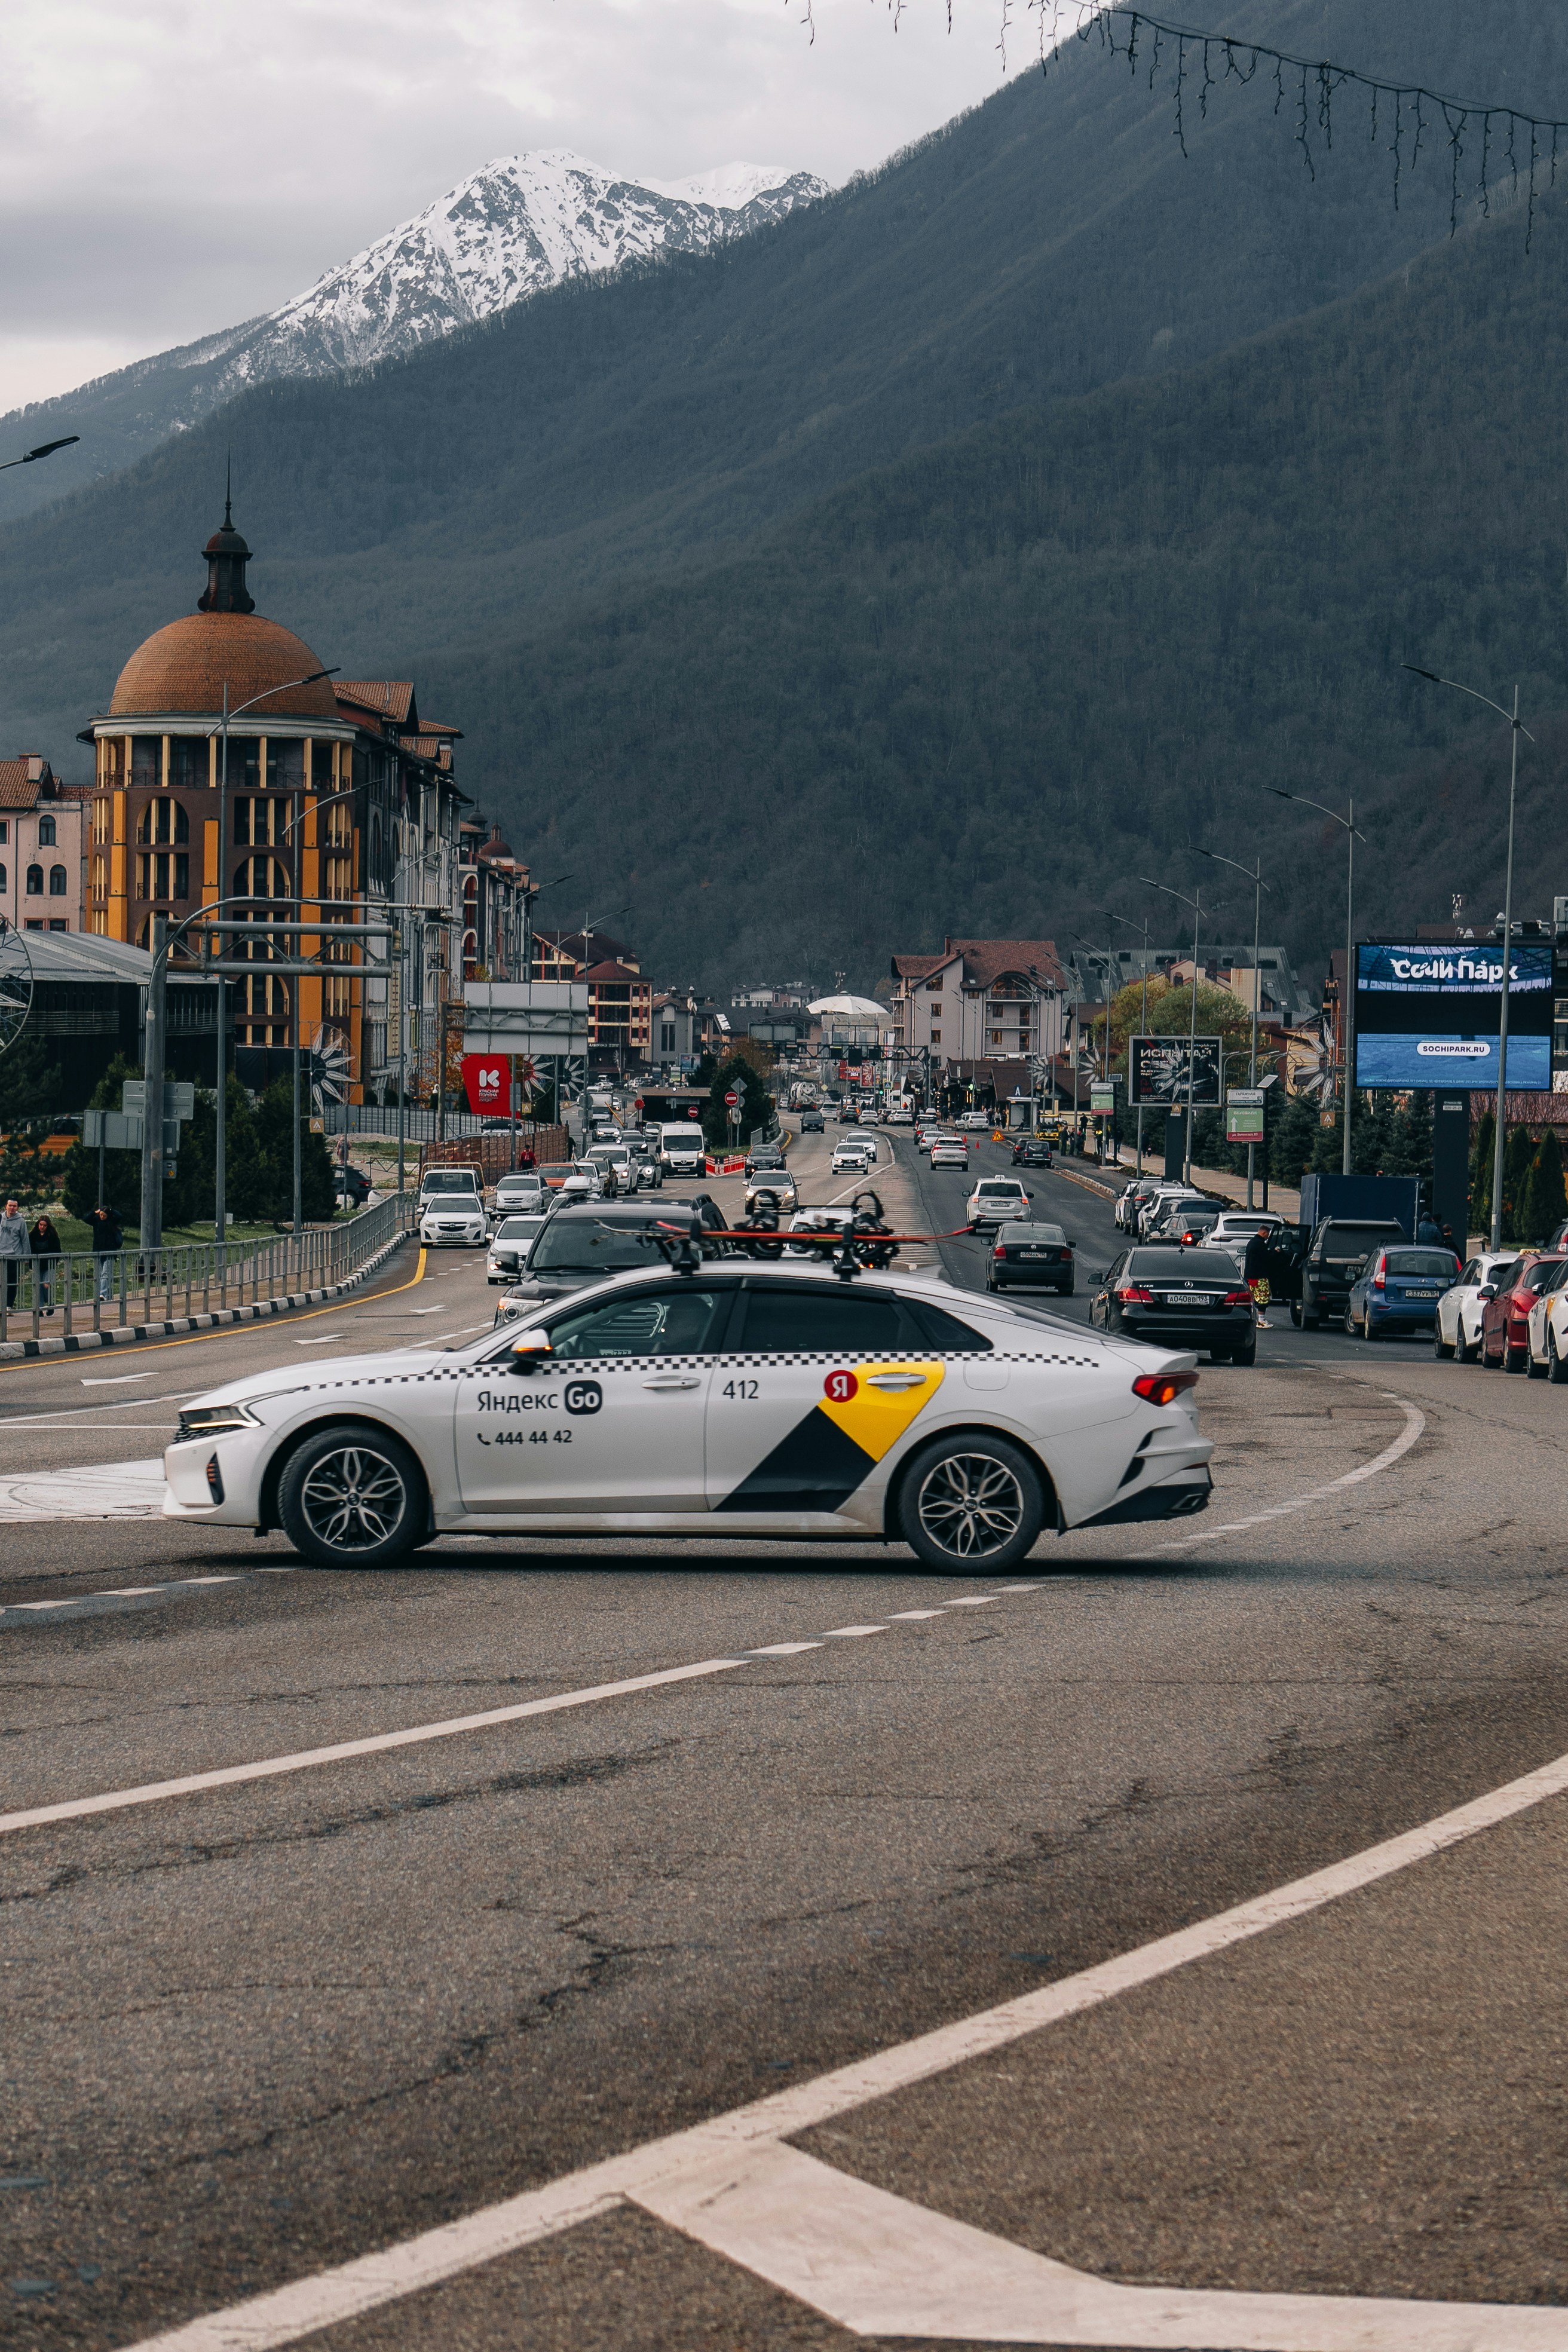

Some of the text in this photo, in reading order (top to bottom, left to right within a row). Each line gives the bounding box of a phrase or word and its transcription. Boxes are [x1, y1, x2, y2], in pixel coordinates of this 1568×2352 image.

[1389, 956, 1518, 983] Сочи Парк
[722, 1380, 759, 1399] 412
[832, 1376, 847, 1397] Я
[478, 1387, 599, 1413] Яндекс Go
[495, 1430, 572, 1445] 444 44 42
